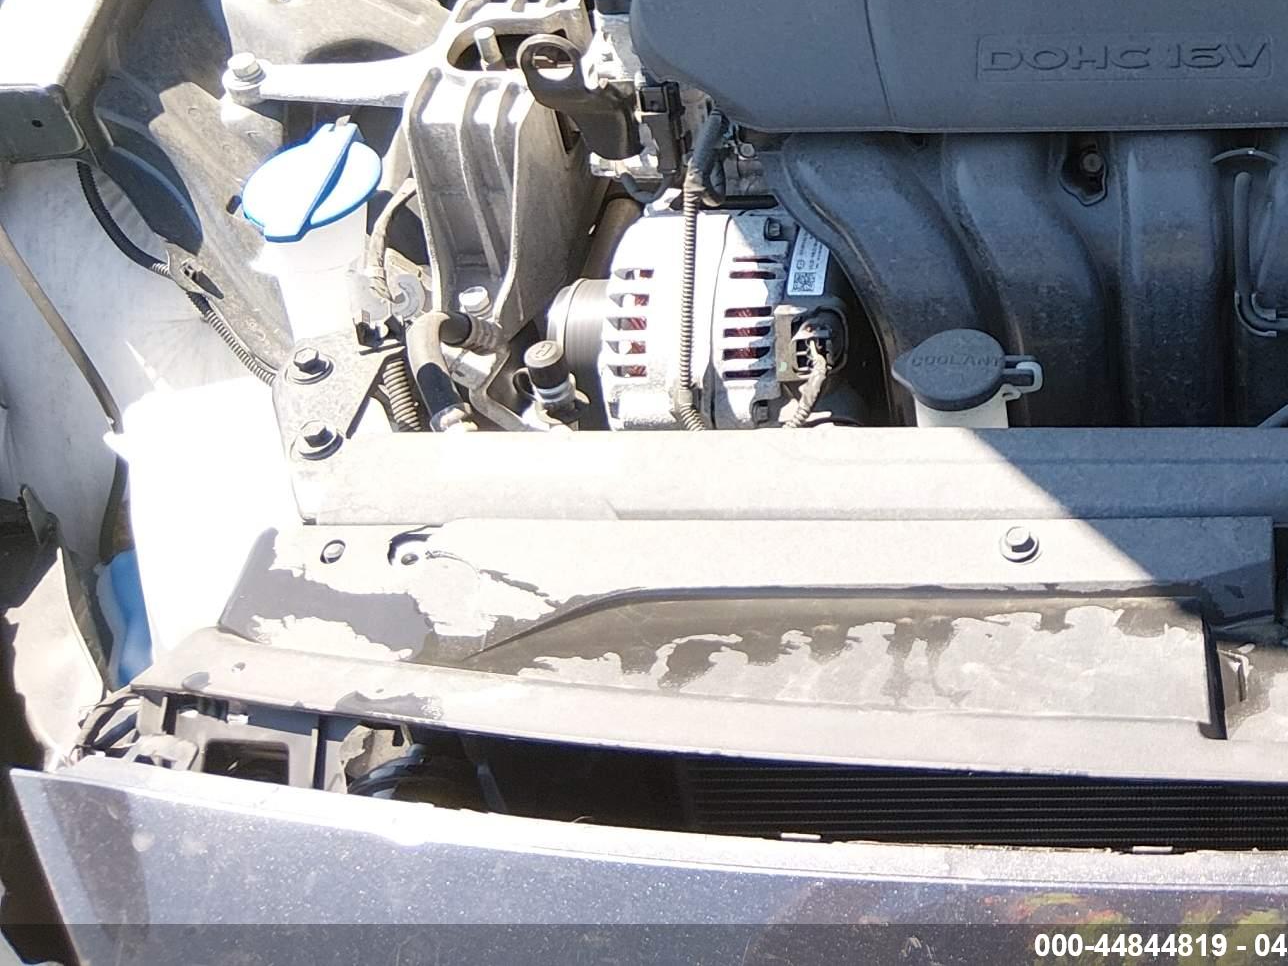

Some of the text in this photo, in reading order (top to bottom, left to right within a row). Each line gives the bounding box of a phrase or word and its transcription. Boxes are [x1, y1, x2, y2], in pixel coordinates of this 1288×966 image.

[982, 42, 1268, 71] DOHC 16V
[911, 353, 1001, 368] COOLANT
